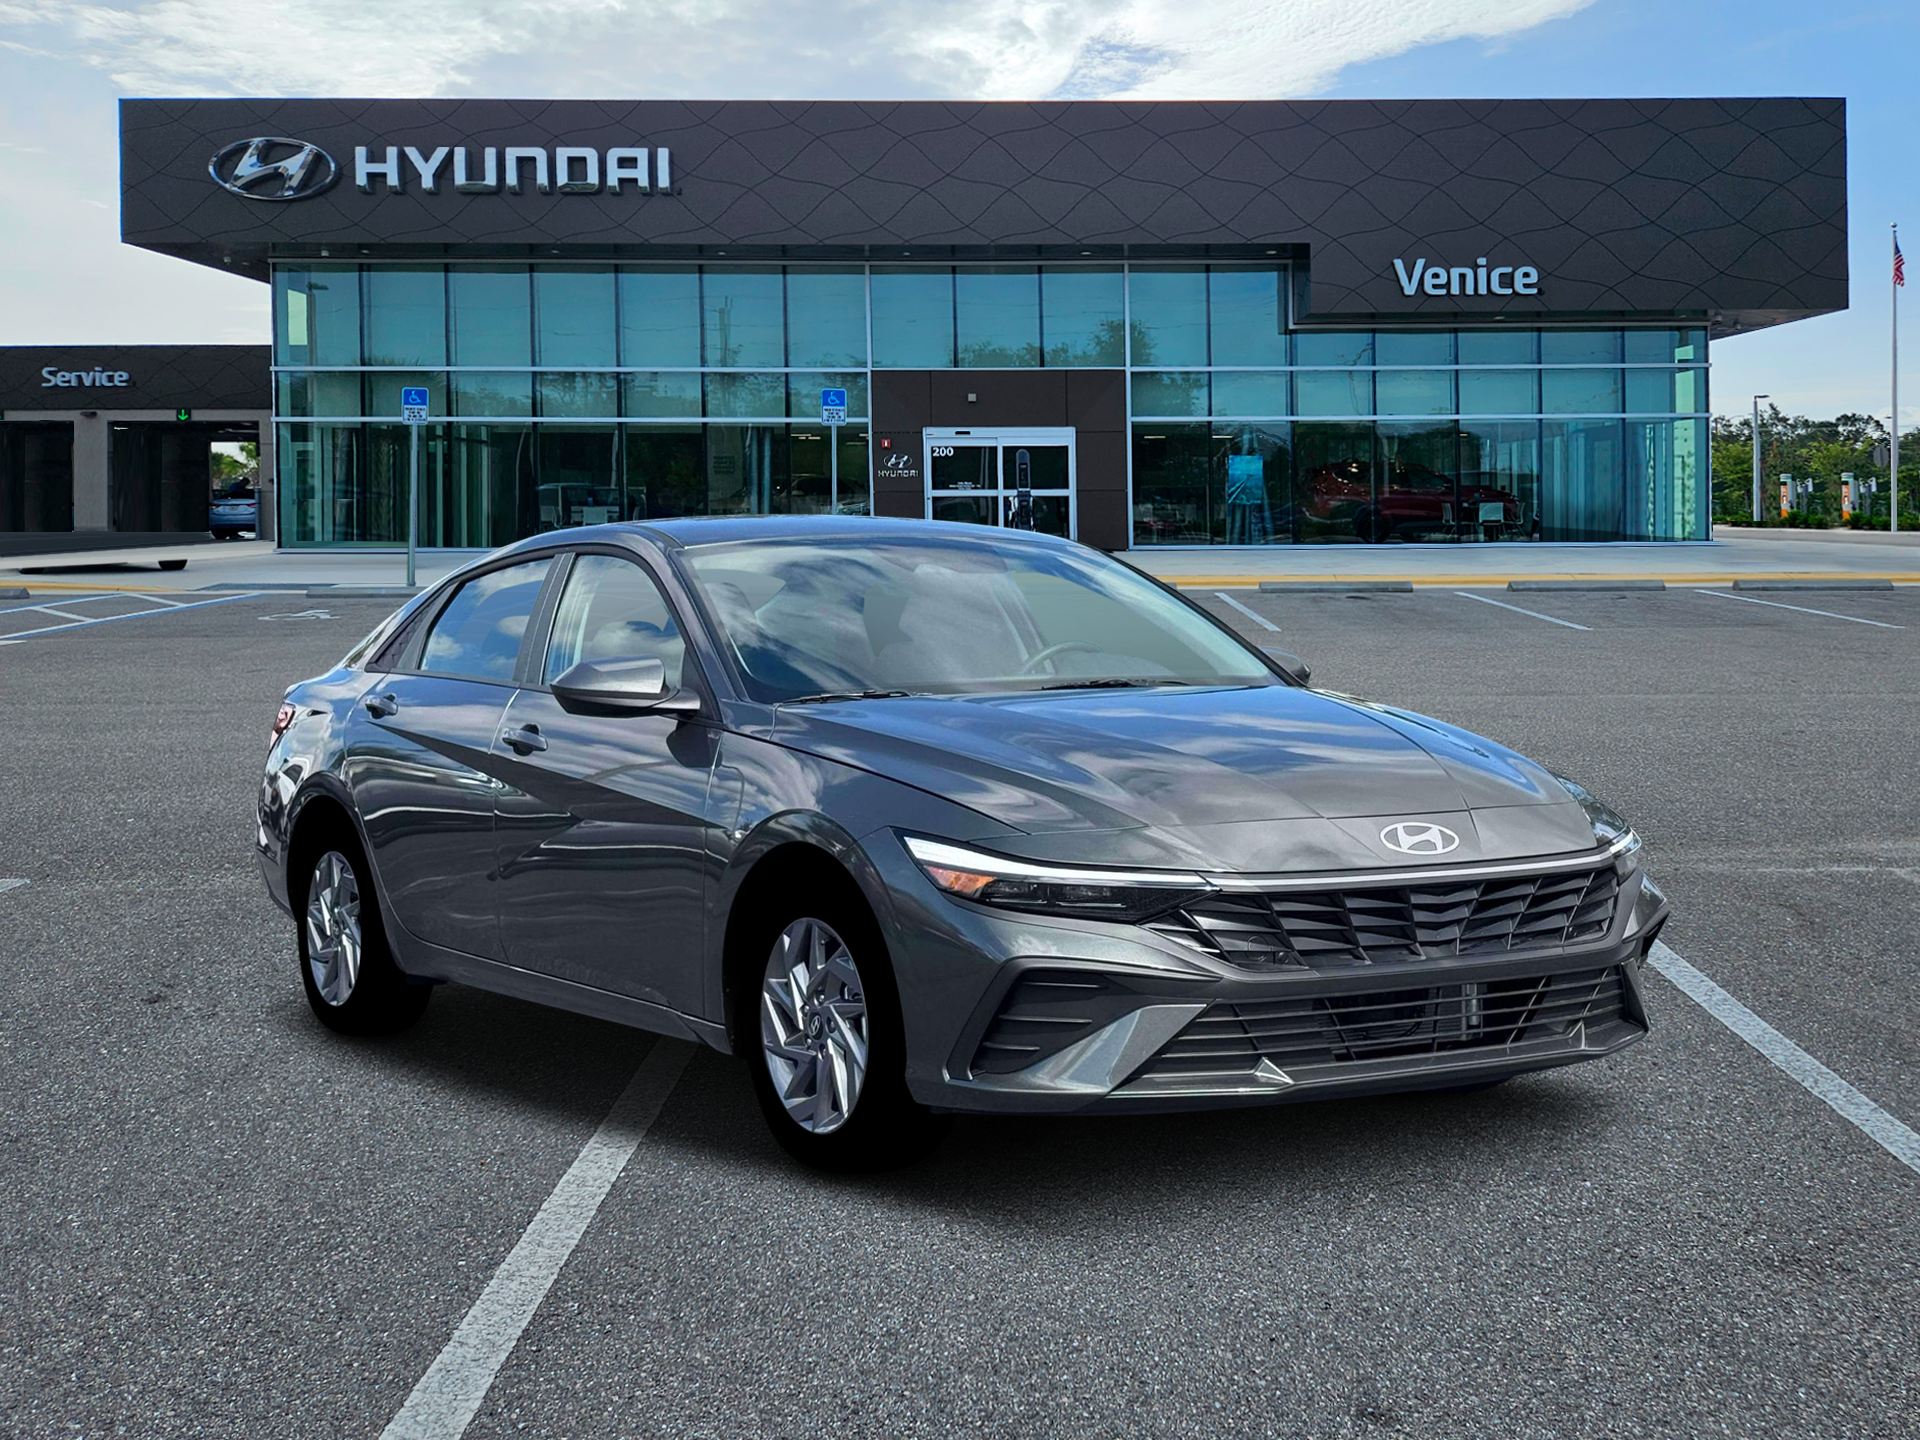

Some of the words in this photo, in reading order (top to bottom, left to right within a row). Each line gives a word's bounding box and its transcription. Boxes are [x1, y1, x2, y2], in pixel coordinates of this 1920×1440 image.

[355, 146, 671, 194] HYUNDAI
[1392, 257, 1539, 296] Venice
[41, 366, 130, 387] Service
[932, 447, 954, 457] 200
[878, 470, 919, 478] HYUNDAI
